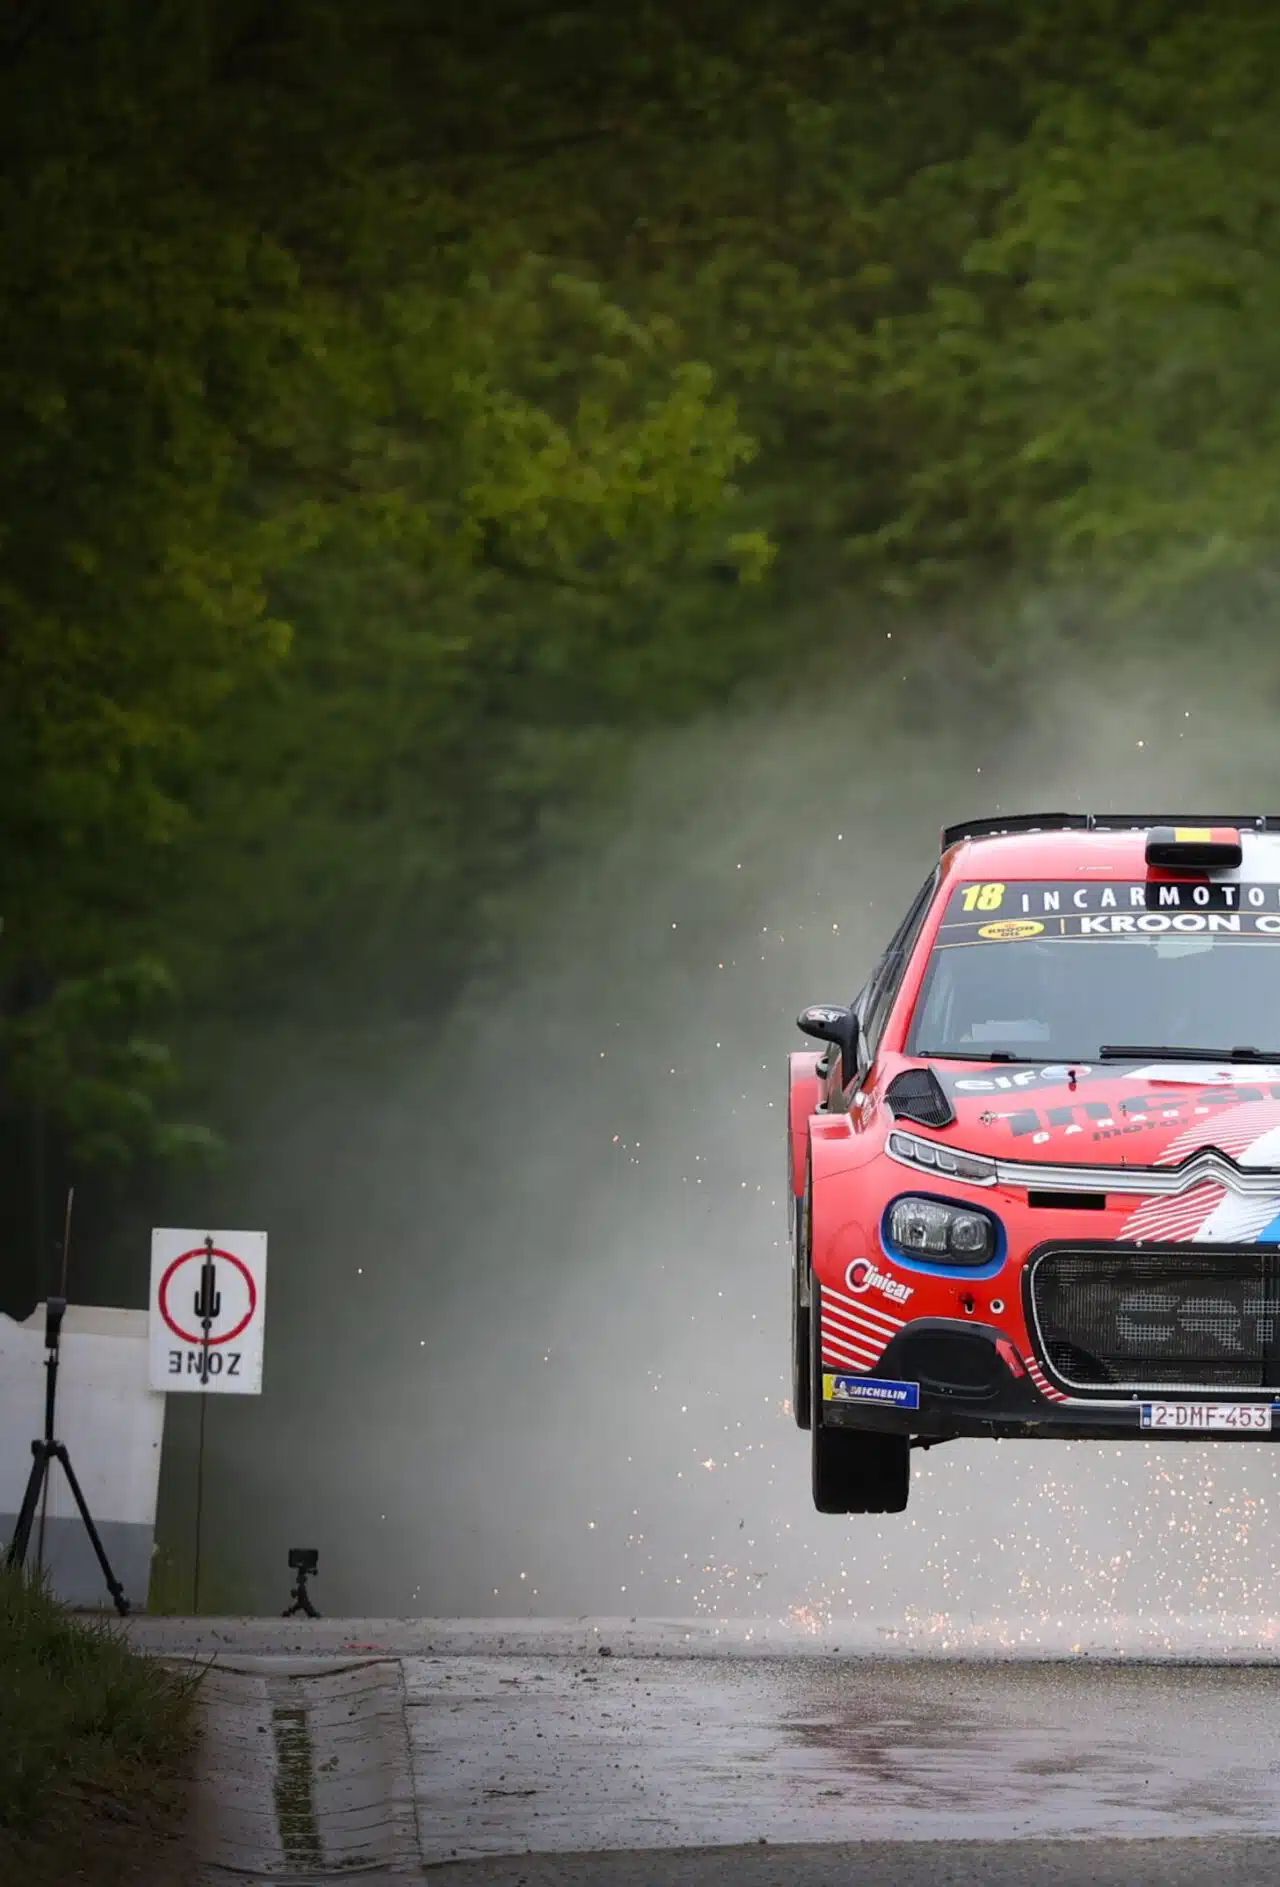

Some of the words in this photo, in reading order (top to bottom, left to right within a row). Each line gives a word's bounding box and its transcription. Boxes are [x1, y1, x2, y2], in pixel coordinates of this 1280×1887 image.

[961, 883, 1006, 911] 18
[1080, 914, 1240, 934] KROON
[845, 1257, 914, 1302] Clinicar
[168, 1351, 241, 1375] ZONE
[850, 1386, 908, 1400] MICHELIN
[1155, 1405, 1267, 1428] 2-DMF-453
